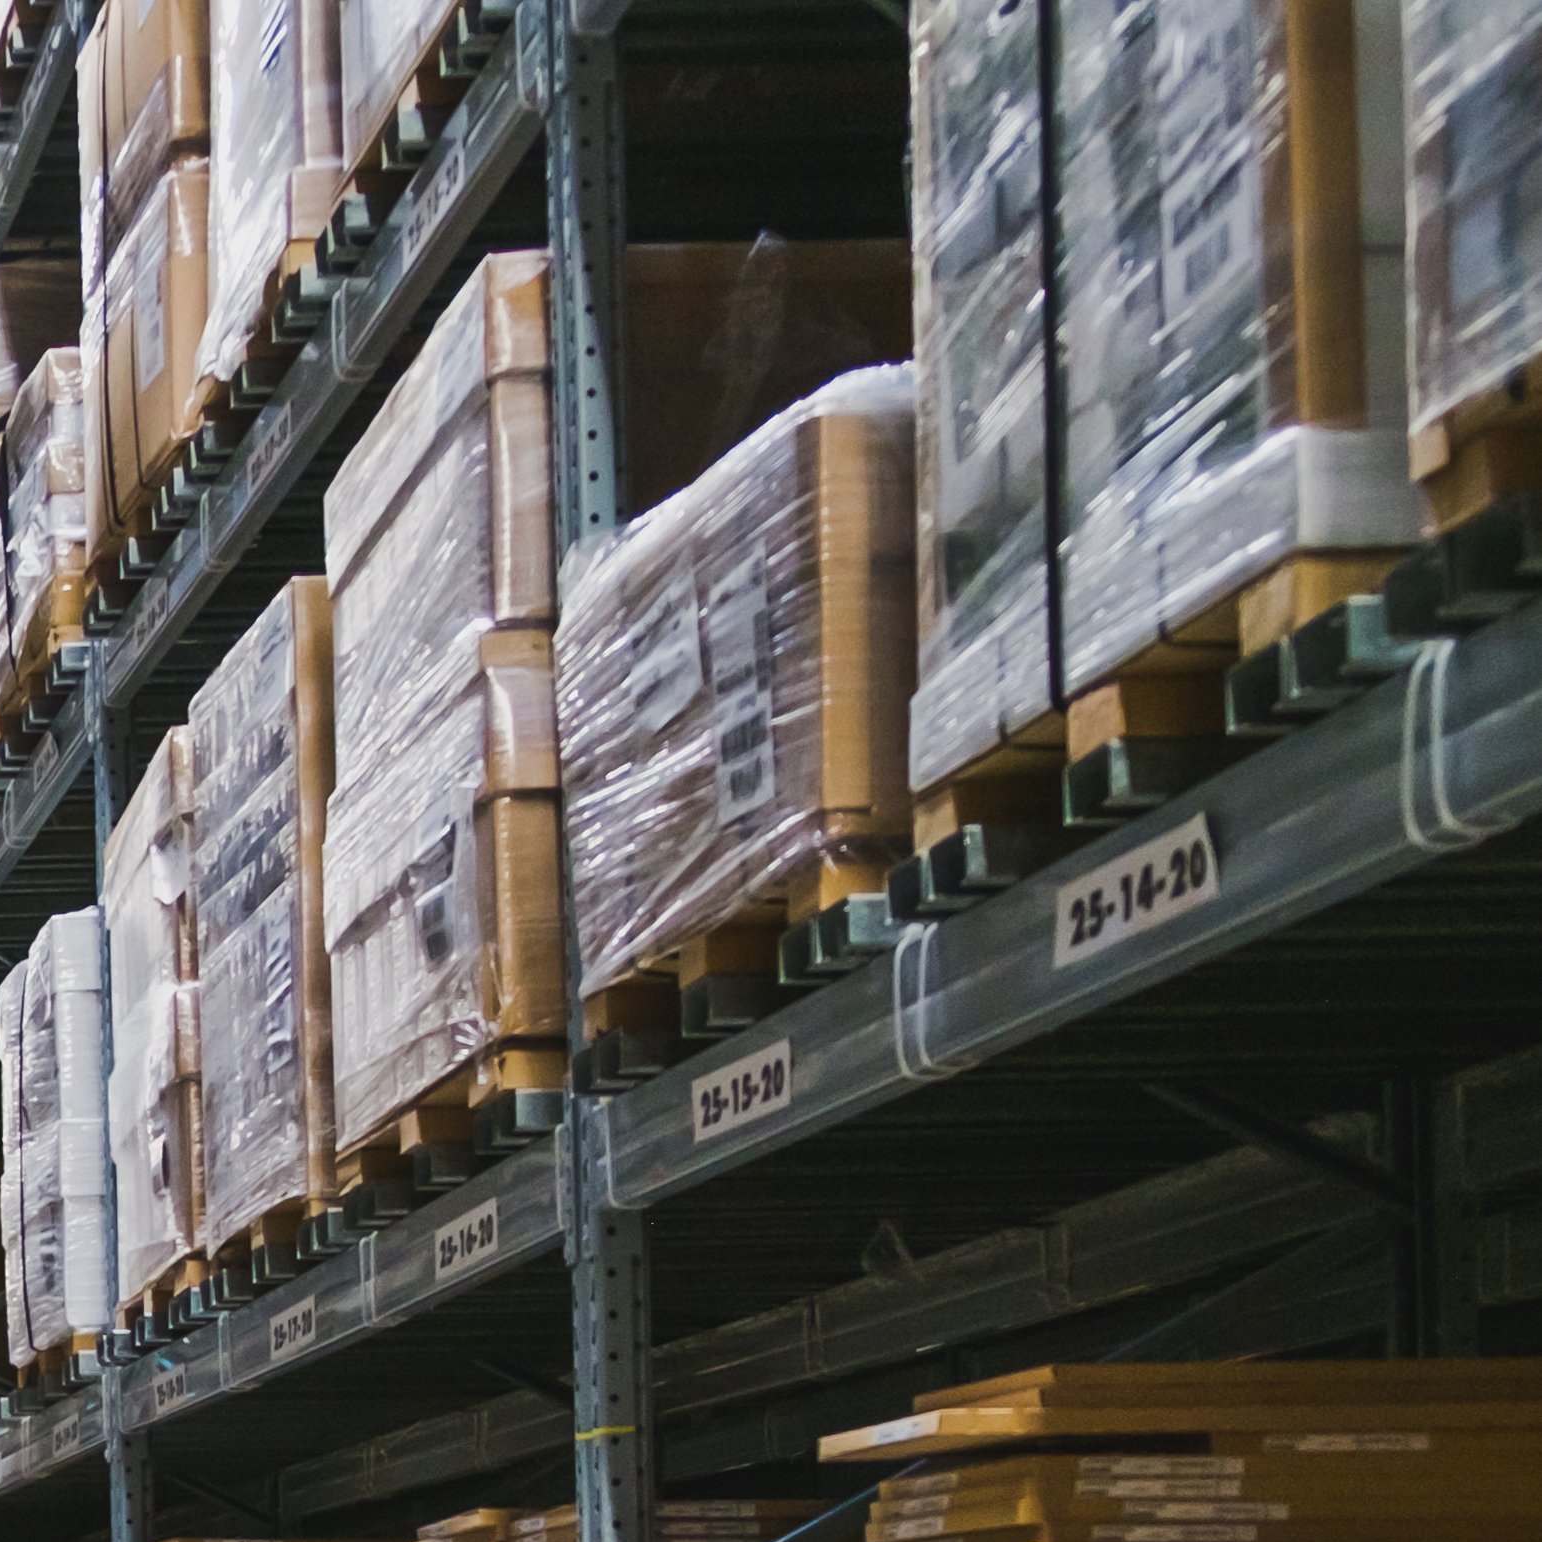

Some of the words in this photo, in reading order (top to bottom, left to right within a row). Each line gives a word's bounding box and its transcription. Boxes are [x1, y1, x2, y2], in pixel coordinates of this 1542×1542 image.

[1070, 839, 1207, 946] 25-14-20
[700, 1058, 784, 1128] 25-15-20
[440, 1214, 493, 1269] 25-16-20
[274, 1308, 312, 1351] 25-17-20
